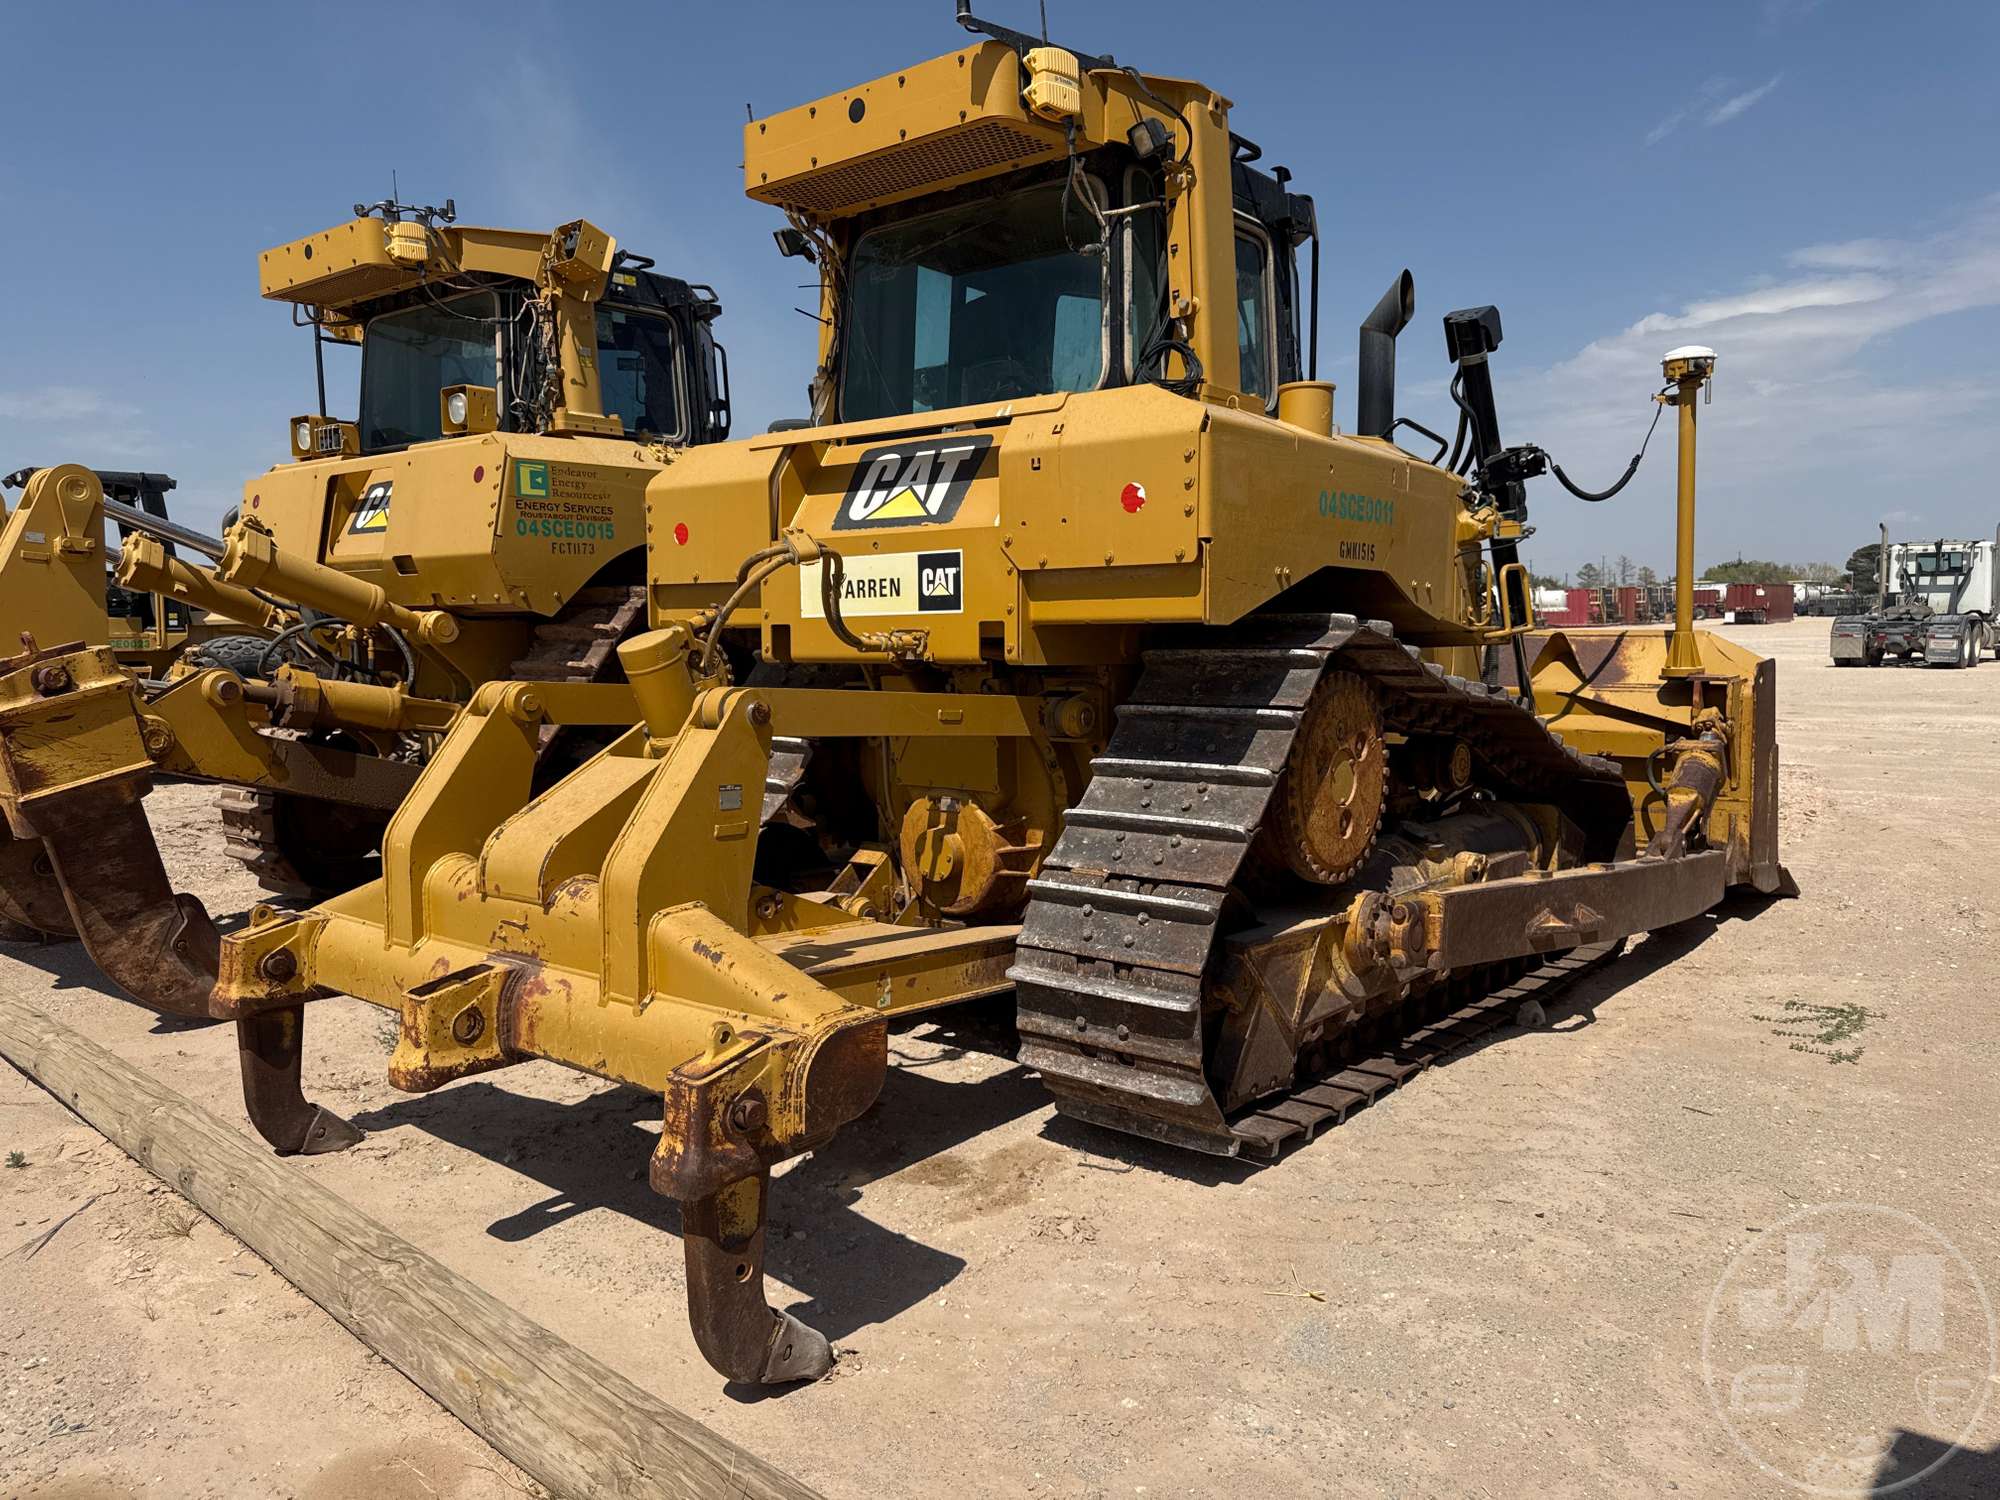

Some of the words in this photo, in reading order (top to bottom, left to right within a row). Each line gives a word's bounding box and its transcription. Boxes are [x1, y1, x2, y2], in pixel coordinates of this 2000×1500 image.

[551, 466, 598, 478] Endeavor
[551, 478, 586, 490] Energy
[849, 445, 976, 521] CAT
[515, 499, 560, 512] ENERGY
[563, 502, 614, 515] SERVICES
[520, 510, 574, 520] ROUSTABOUT
[1319, 490, 1393, 525] 04SCE0011
[516, 519, 614, 539] 04SCE0015
[551, 542, 595, 554] FCT1173
[841, 577, 901, 599] ARREN
[922, 567, 957, 596] CAT
